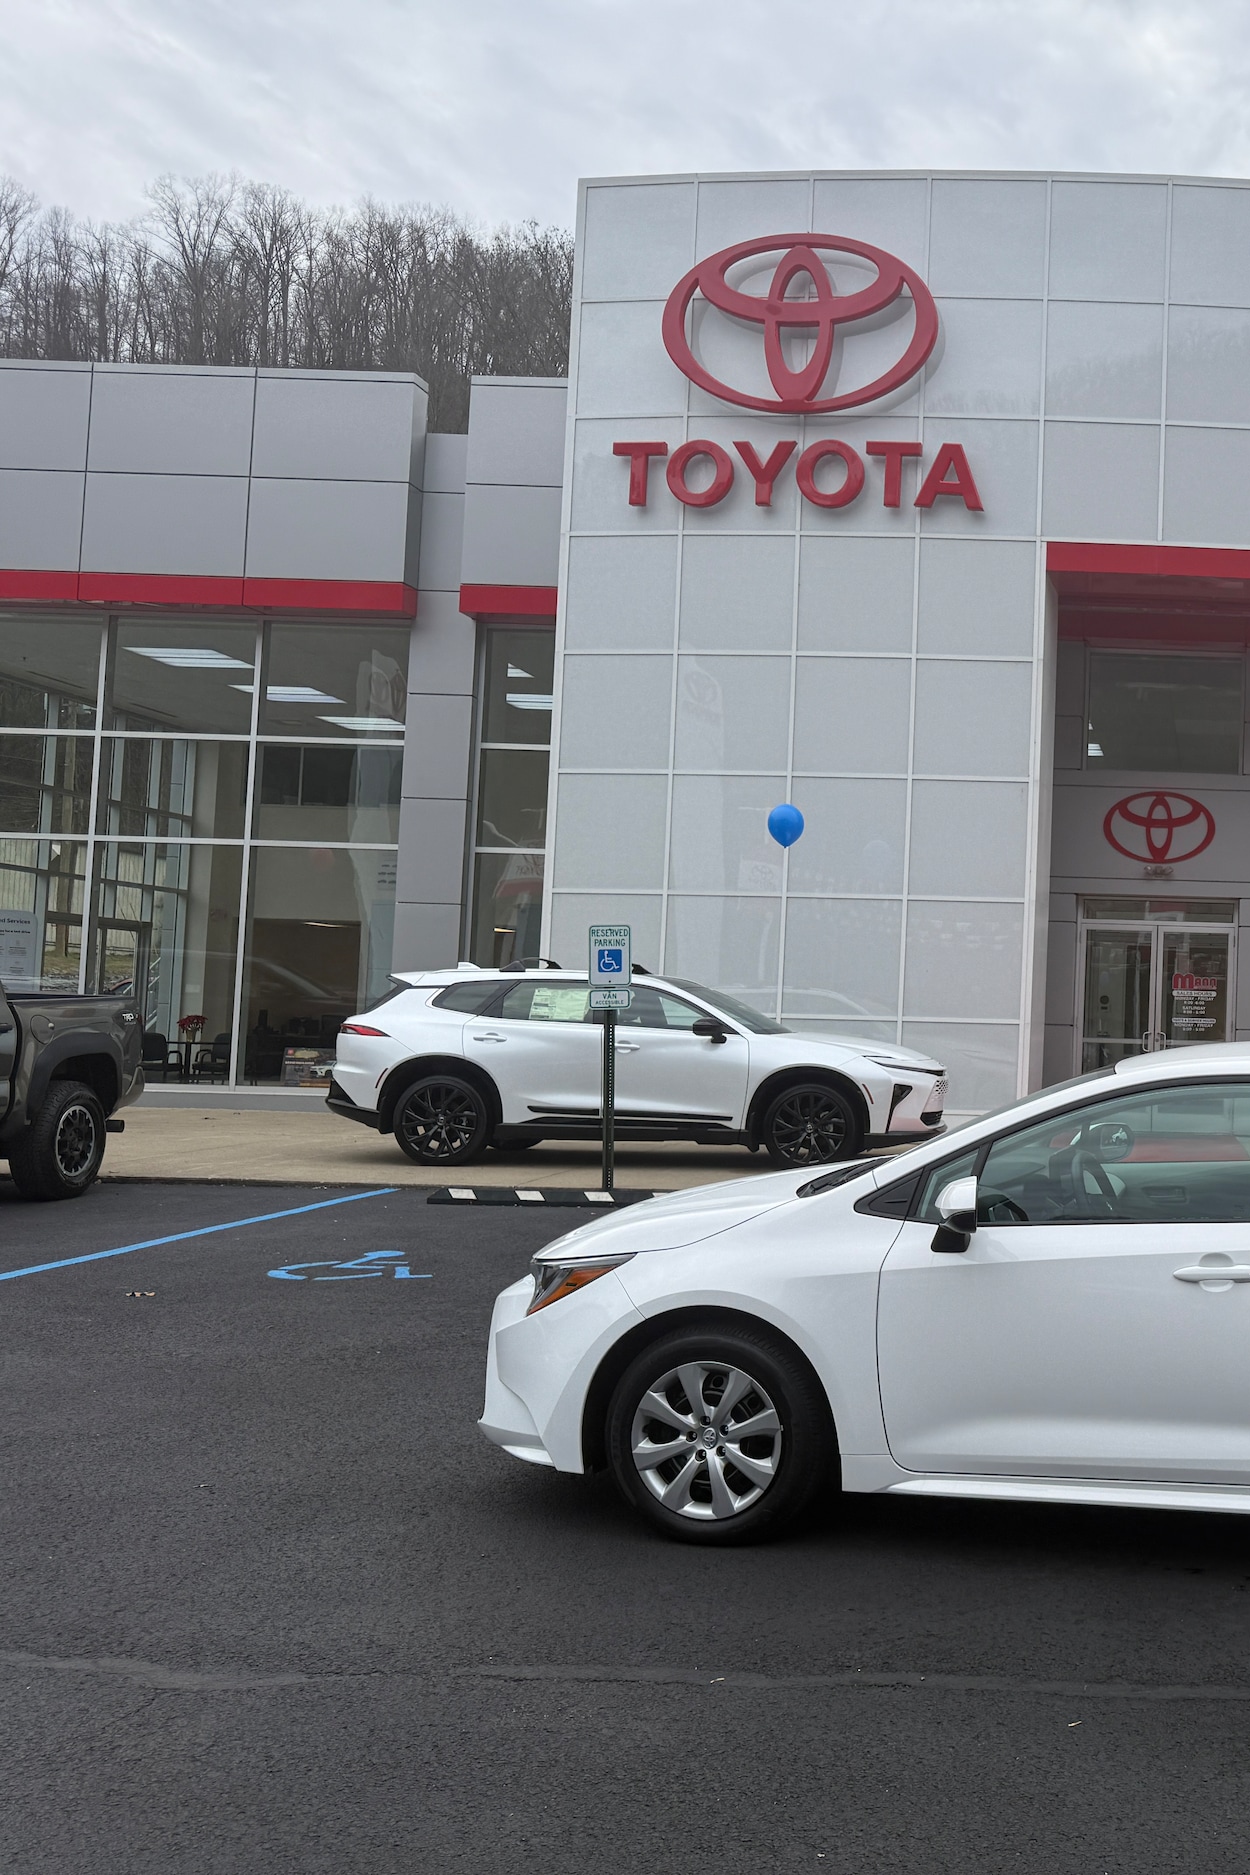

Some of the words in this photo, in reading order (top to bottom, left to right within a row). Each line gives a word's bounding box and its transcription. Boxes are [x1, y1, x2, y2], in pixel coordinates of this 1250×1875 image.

[612, 439, 984, 512] TOYOTA
[591, 928, 629, 938] RESERVED
[594, 938, 626, 947] PARKING
